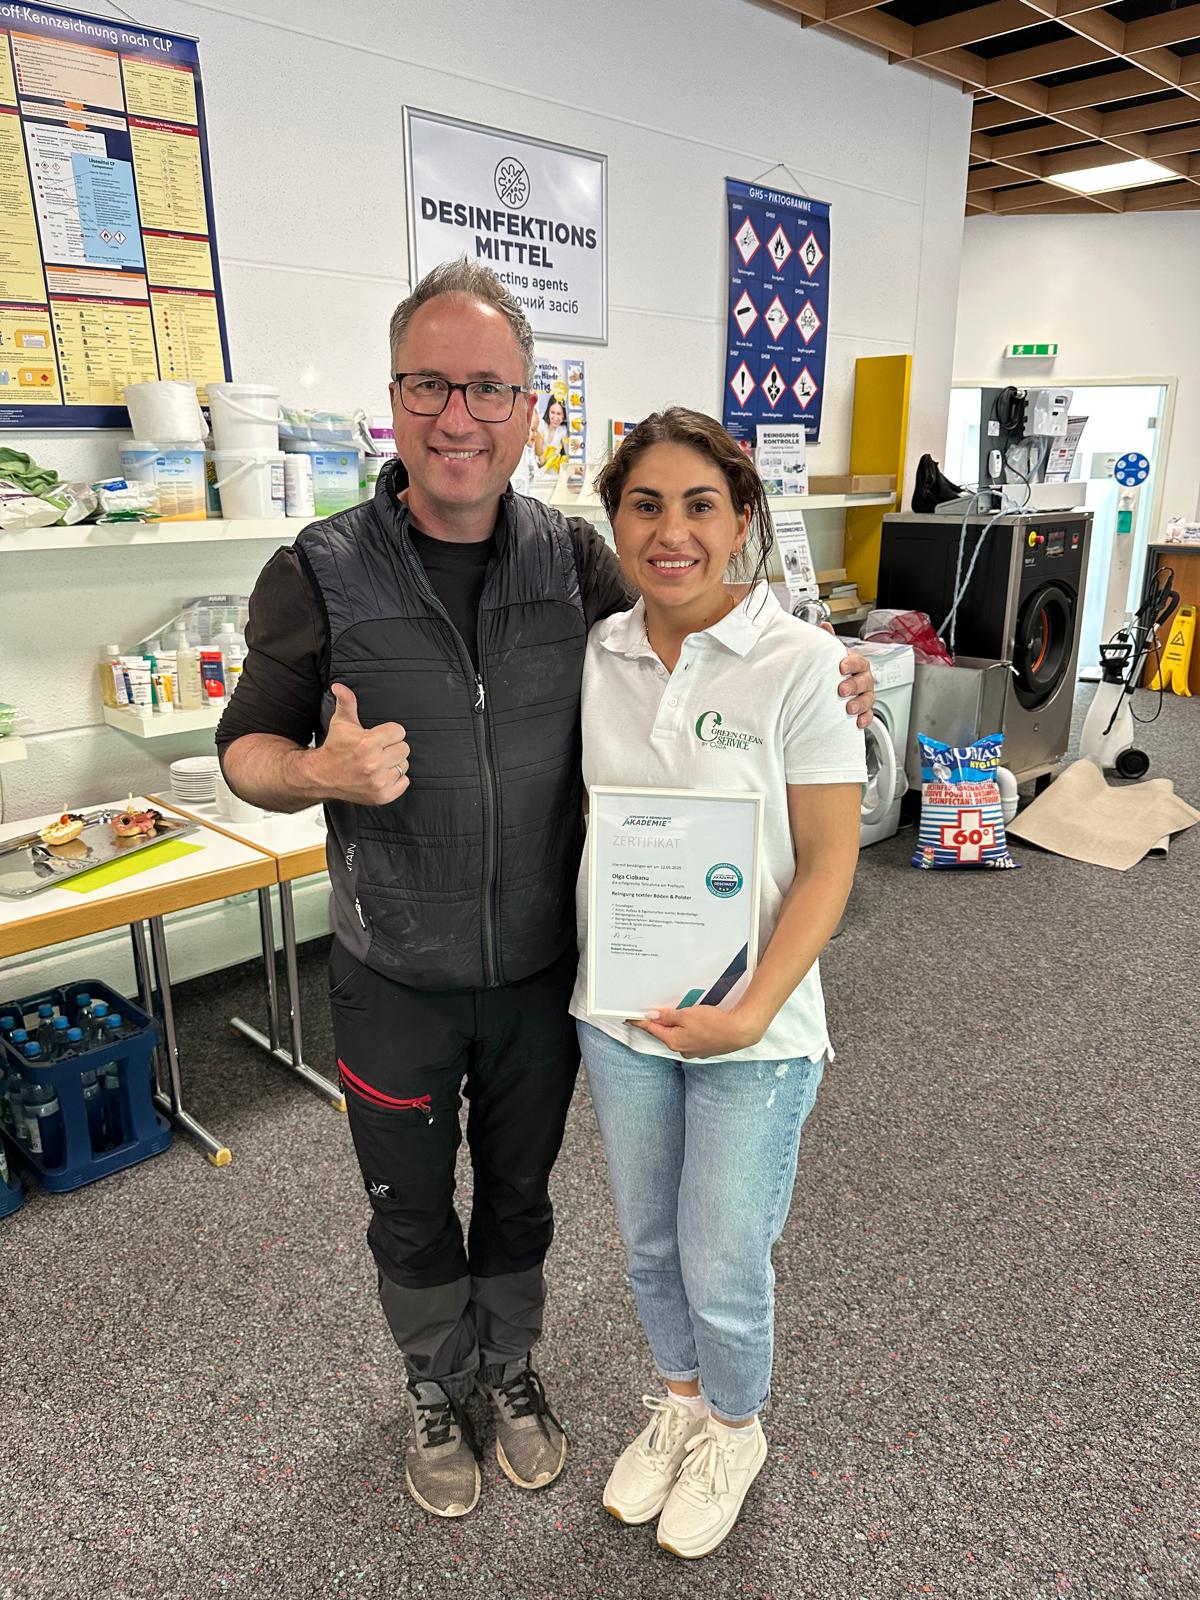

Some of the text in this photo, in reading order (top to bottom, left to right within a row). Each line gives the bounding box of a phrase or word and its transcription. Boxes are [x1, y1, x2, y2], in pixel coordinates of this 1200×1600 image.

[121, 30, 150, 48] nach
[152, 36, 173, 52] CLP
[749, 187, 764, 200] GHS
[768, 192, 812, 212] PIKTOGRAMME
[421, 197, 597, 249] DESINFEKTIONS
[475, 236, 553, 269] MITTEL
[493, 271, 569, 292] ecting agents
[549, 299, 579, 314] засіб
[532, 379, 551, 394] chtig
[711, 728, 763, 745] GREEN CLEAN
[716, 736, 749, 751] SERVICE
[622, 817, 667, 827] AKADEMIE
[611, 835, 681, 849] ZERTIFIKAT
[952, 828, 990, 845] 60°
